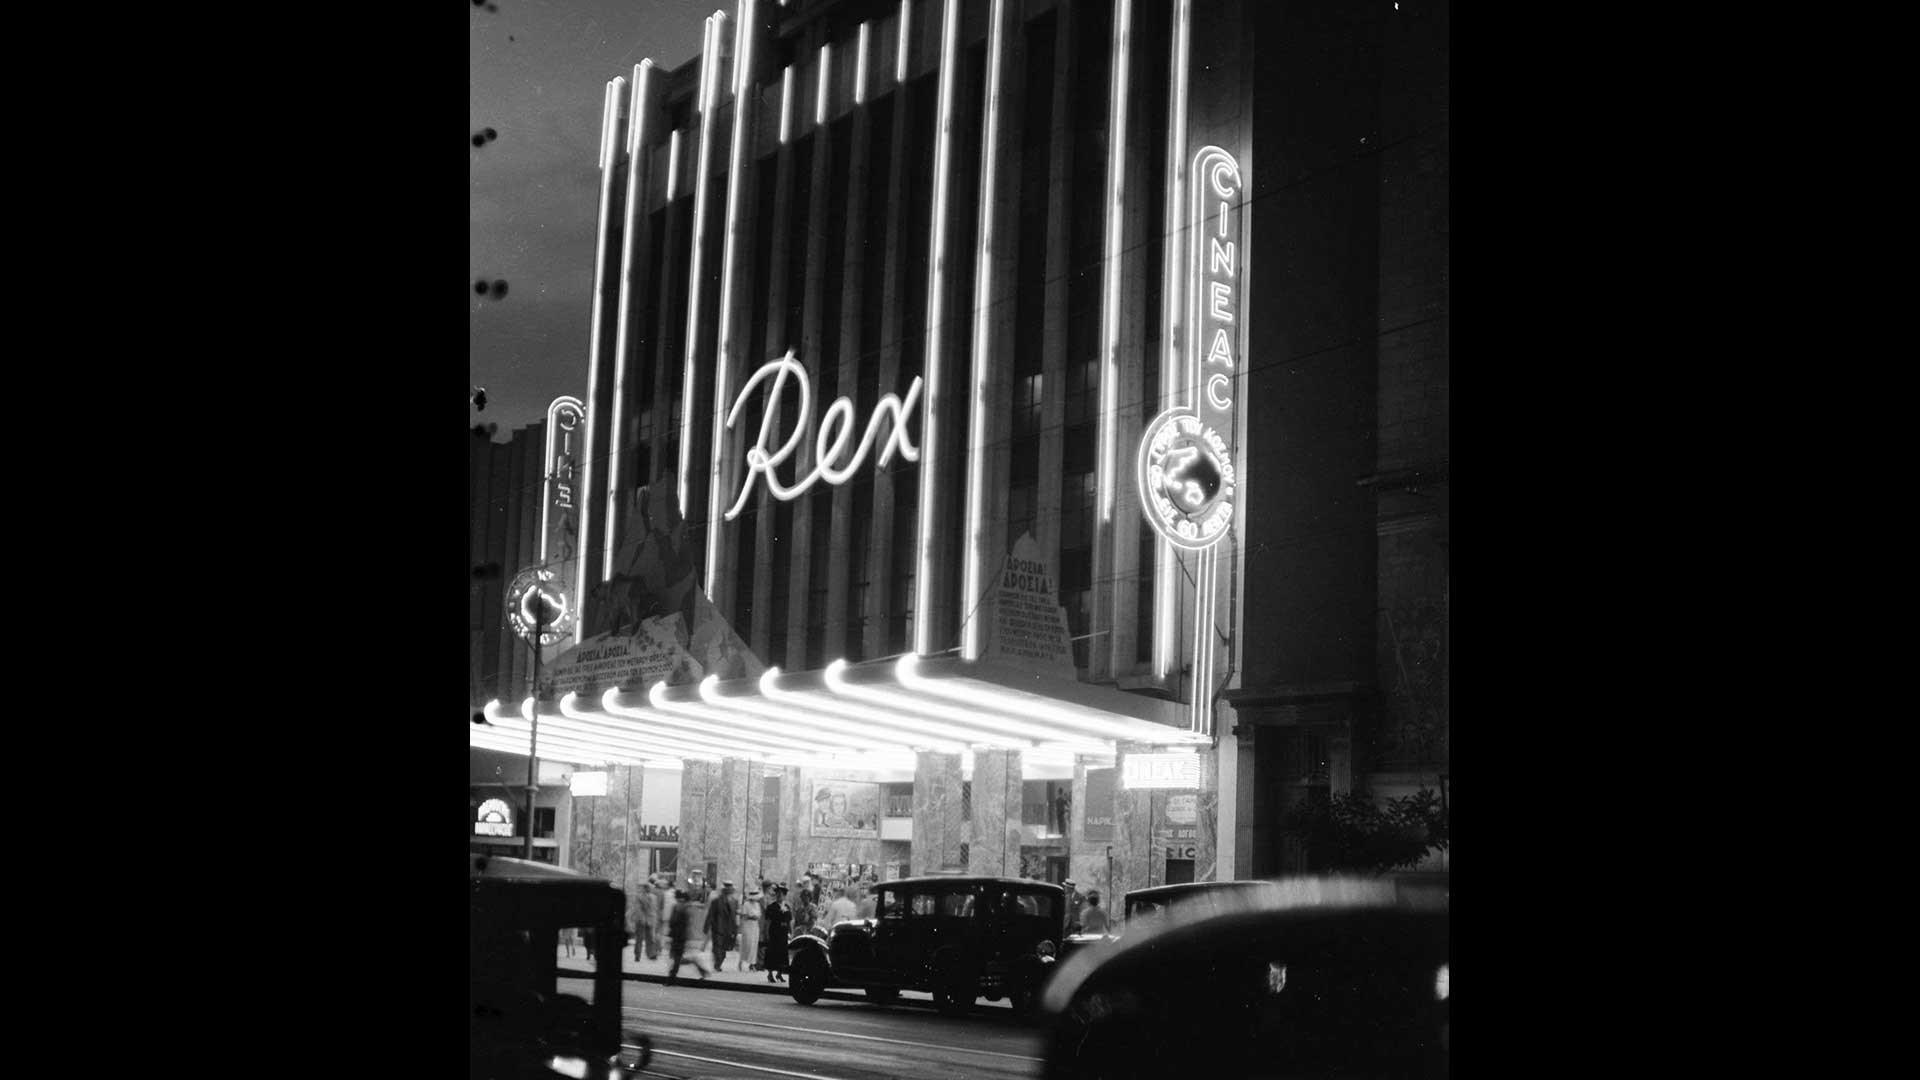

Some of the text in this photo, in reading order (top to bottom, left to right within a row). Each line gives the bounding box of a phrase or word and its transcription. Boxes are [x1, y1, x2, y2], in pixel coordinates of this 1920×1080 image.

[1206, 161, 1235, 411] CINEAC
[724, 348, 923, 521] Rex
[1003, 571, 1052, 594] ΔΡΟΣΙΑ!
[1007, 556, 1047, 576] ΔΡΟΣΙΑ!
